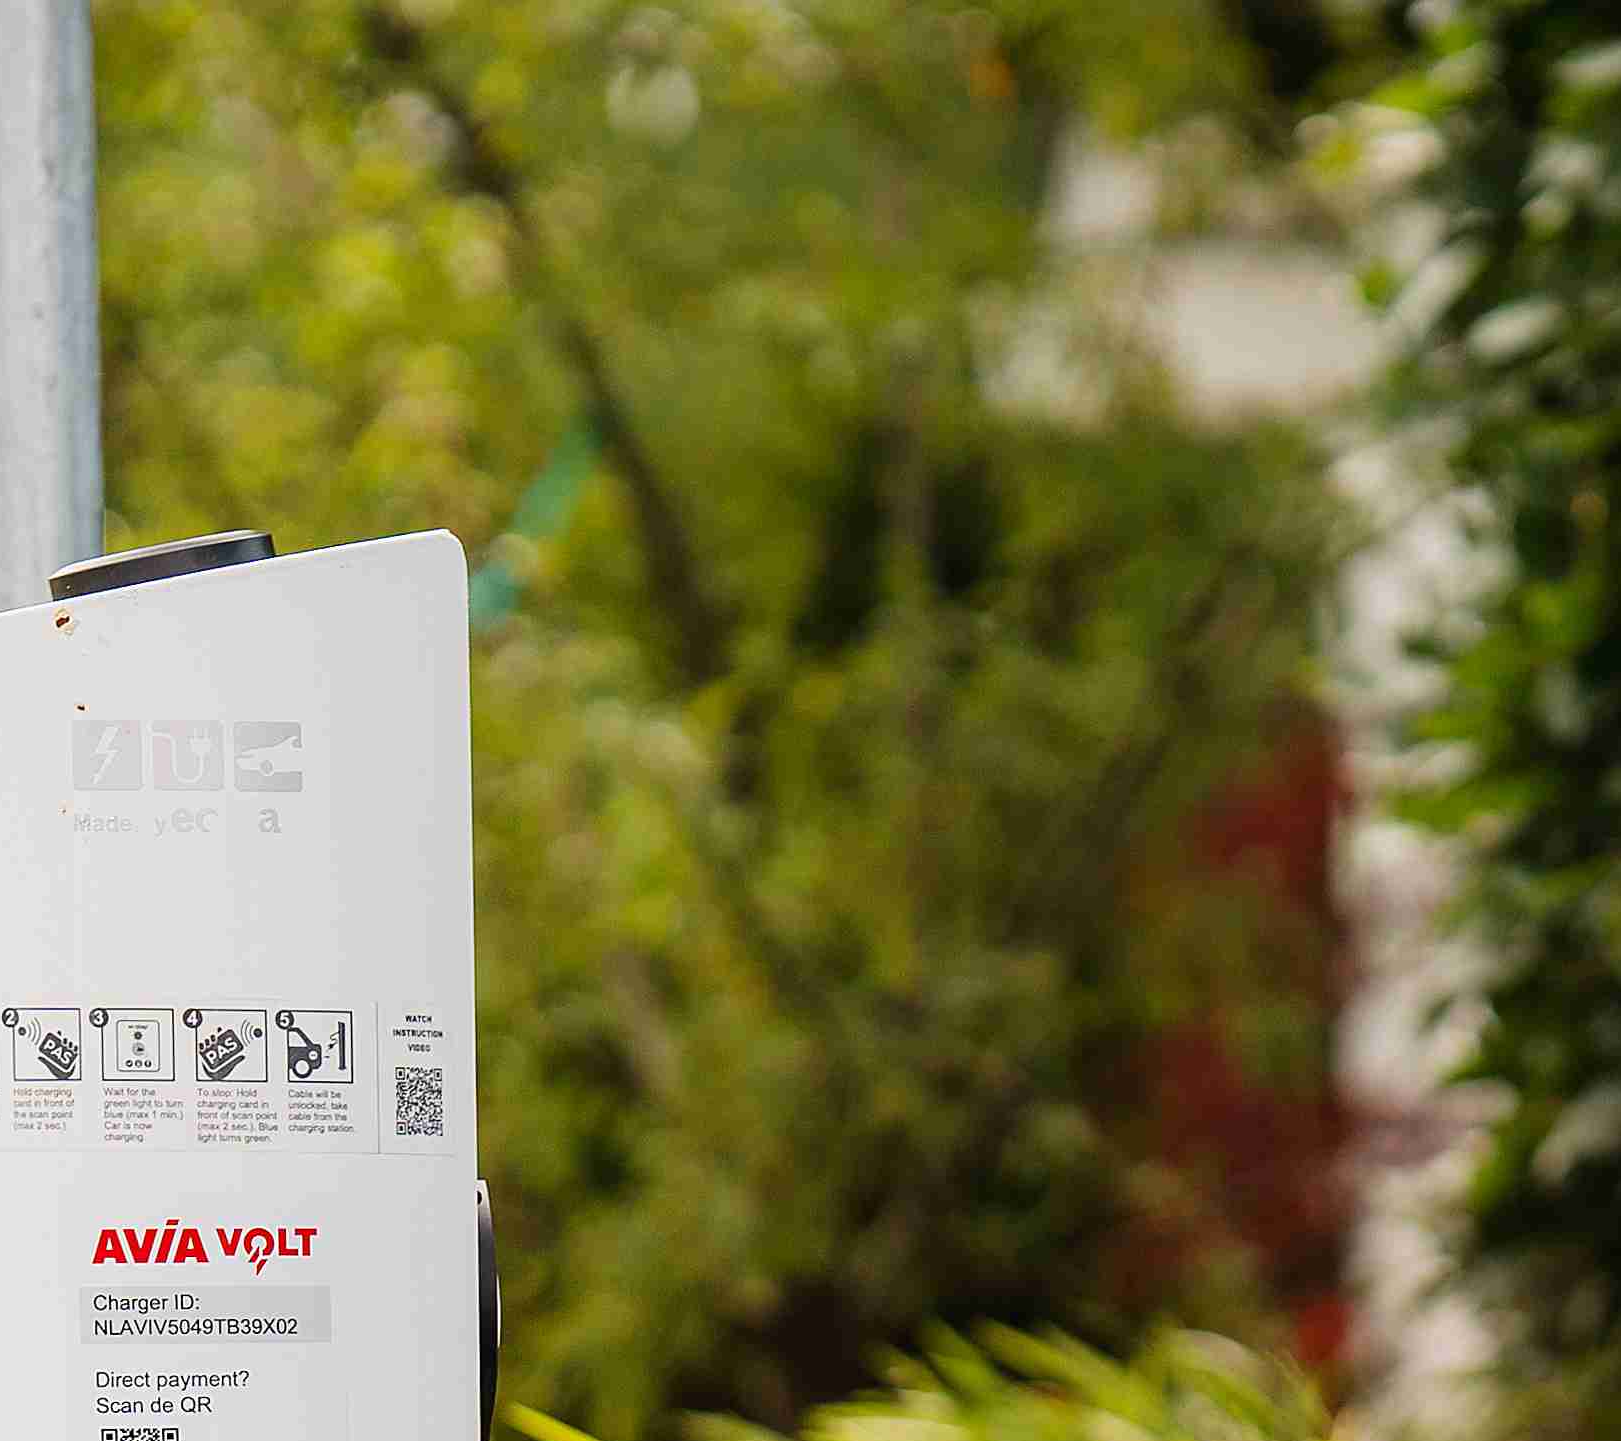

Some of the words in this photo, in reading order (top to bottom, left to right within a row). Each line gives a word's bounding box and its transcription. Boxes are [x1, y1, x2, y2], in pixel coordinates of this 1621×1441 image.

[405, 1015, 433, 1024] WATCH
[392, 1028, 443, 1039] INSTRUCTION
[43, 1039, 73, 1065] PAS
[206, 1036, 238, 1065] PAS
[407, 1043, 431, 1052] VIDEO
[216, 1226, 318, 1276] VOLT
[93, 1294, 169, 1314] Charger
[175, 1294, 201, 1311] ID:
[94, 1318, 298, 1336] NLAVIV5049TB39X02
[96, 1371, 151, 1388] Direct
[157, 1370, 250, 1391] payment?
[96, 1397, 144, 1414] Scan
[150, 1397, 174, 1413] de
[180, 1396, 213, 1414] QR
